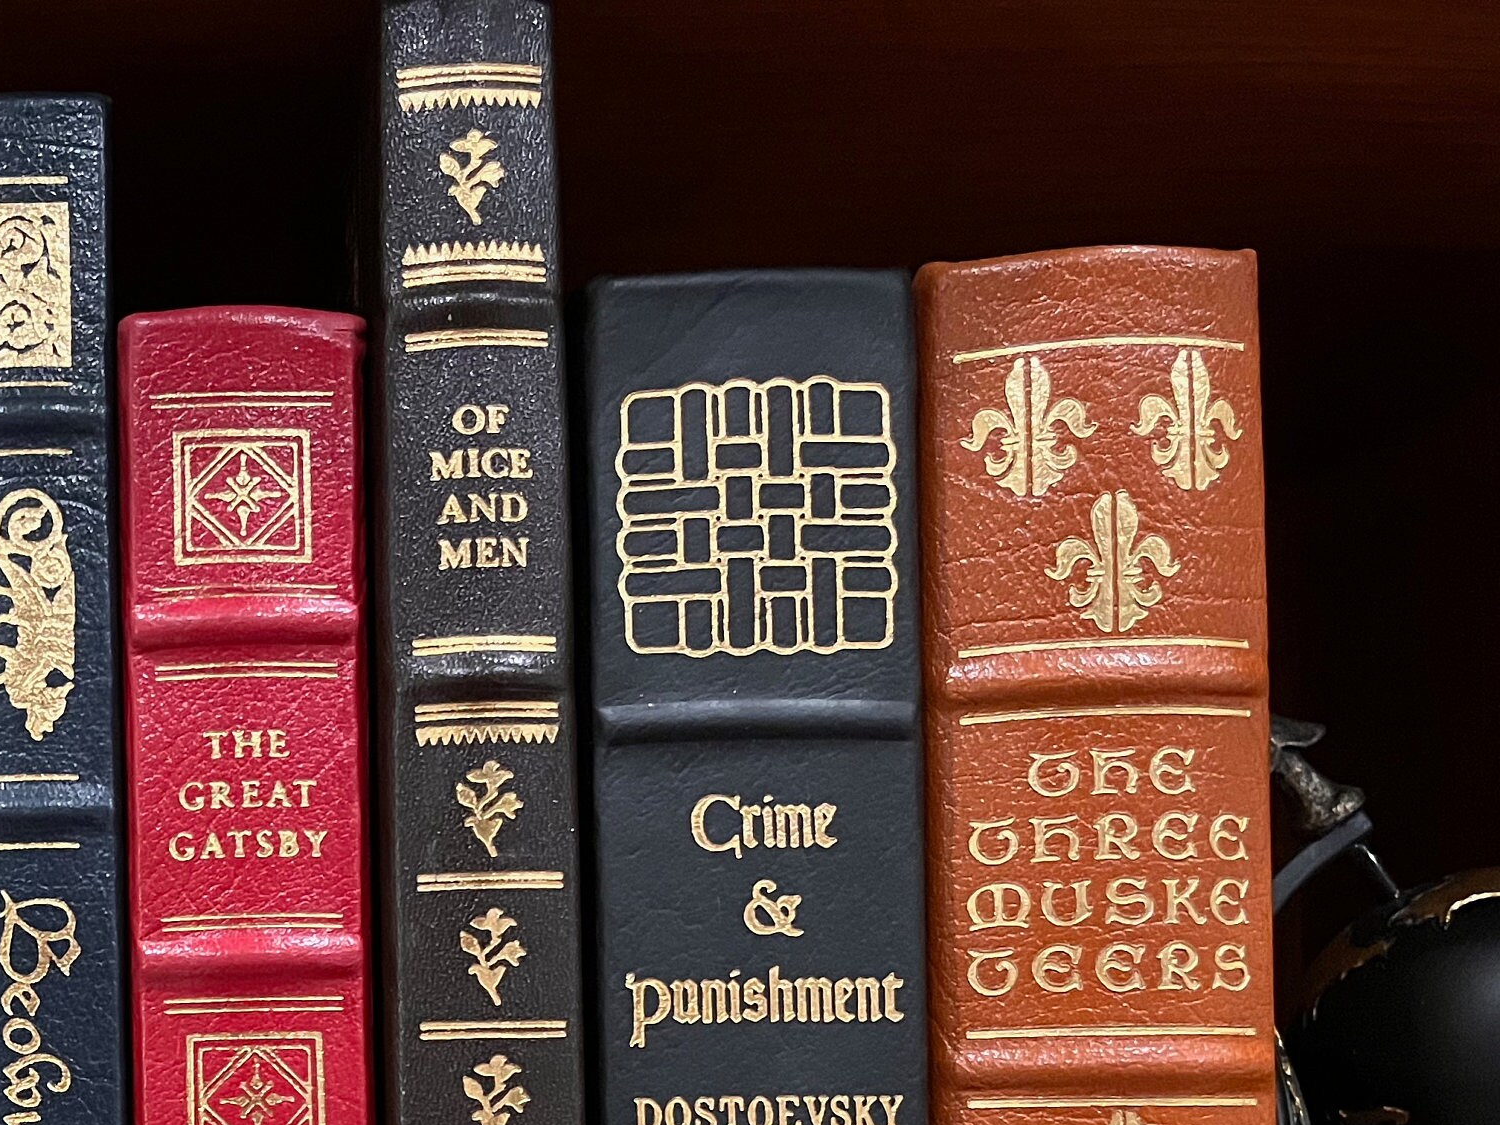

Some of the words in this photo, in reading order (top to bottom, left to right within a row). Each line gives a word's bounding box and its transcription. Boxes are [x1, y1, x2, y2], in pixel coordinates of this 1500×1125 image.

[451, 404, 510, 436] OF
[429, 448, 534, 483] MICE
[436, 493, 529, 526] AND
[437, 537, 529, 571] MEN
[203, 729, 291, 761] THE
[1027, 745, 1196, 797] THE
[178, 779, 318, 812] GREAT
[690, 794, 838, 860] Crime
[967, 811, 1250, 866] THREE
[168, 829, 329, 863] GATSBY
[742, 879, 805, 937] &
[966, 877, 1251, 931] MUSKE
[966, 943, 1252, 997] TEERS
